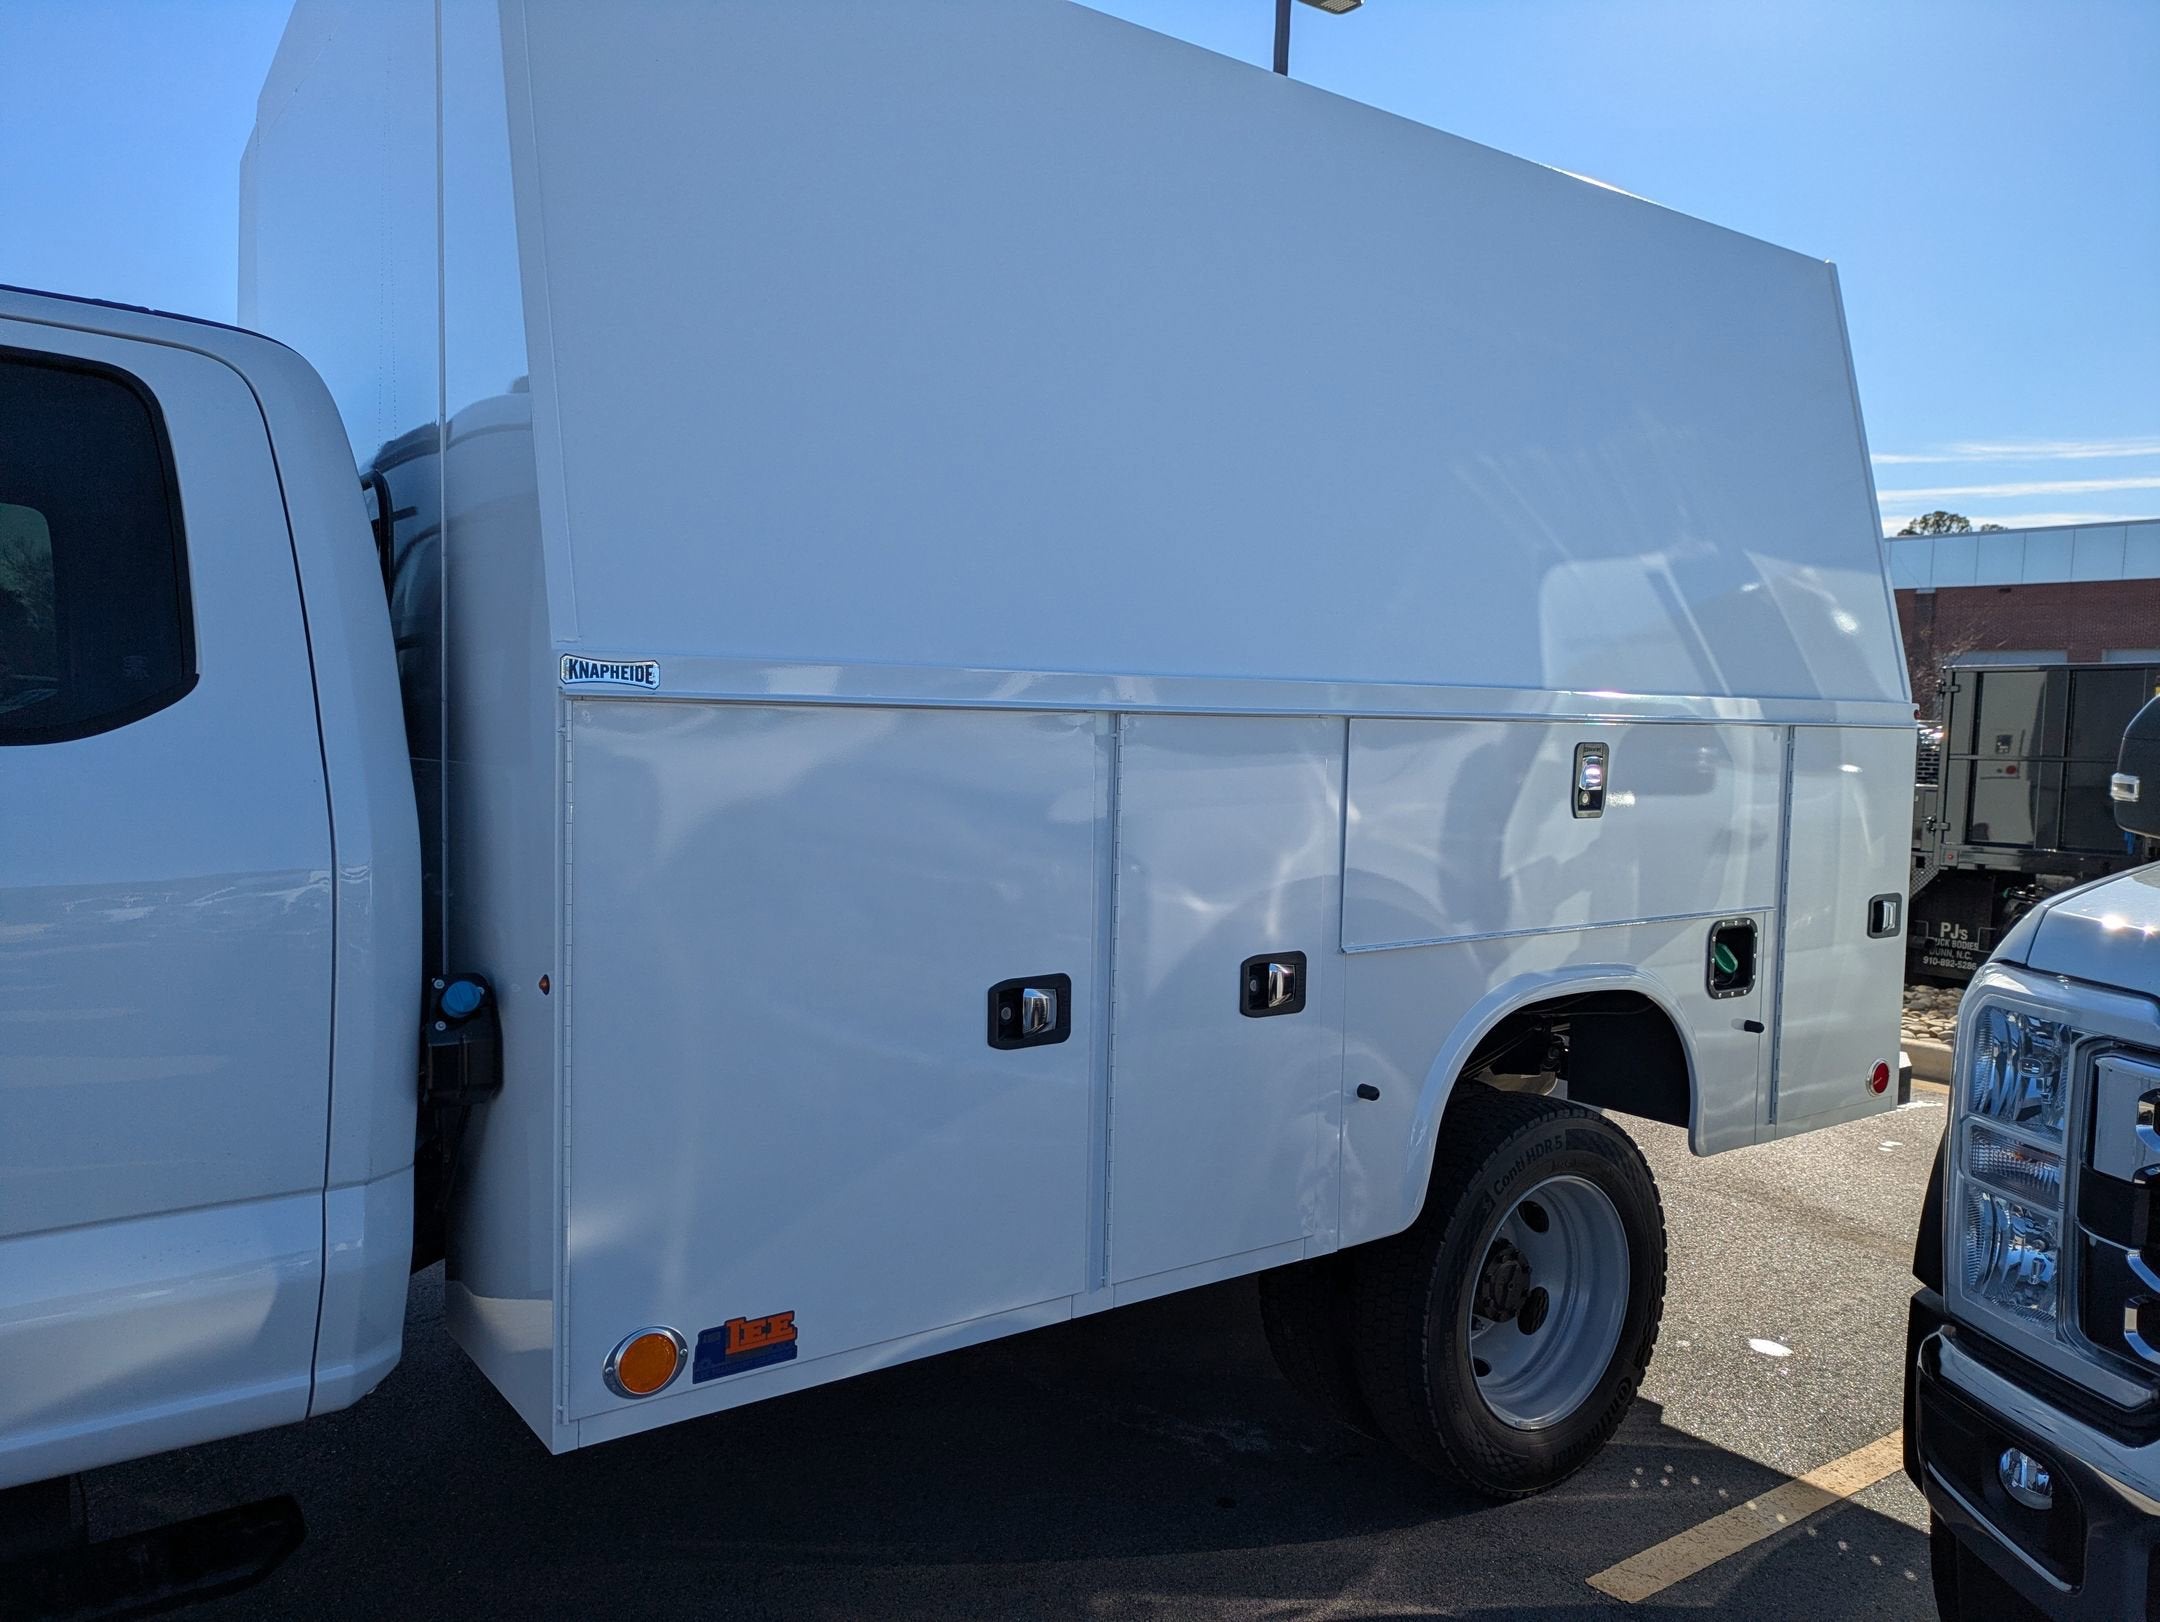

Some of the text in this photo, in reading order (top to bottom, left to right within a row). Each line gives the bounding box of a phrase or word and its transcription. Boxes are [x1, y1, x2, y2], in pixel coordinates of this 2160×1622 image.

[568, 658, 655, 685] KNAPHEIDE
[1951, 940, 1979, 951] BODIES
[1493, 1156, 1526, 1195] Conti
[1525, 1139, 1554, 1164] HDR
[1554, 1135, 1563, 1150] 5
